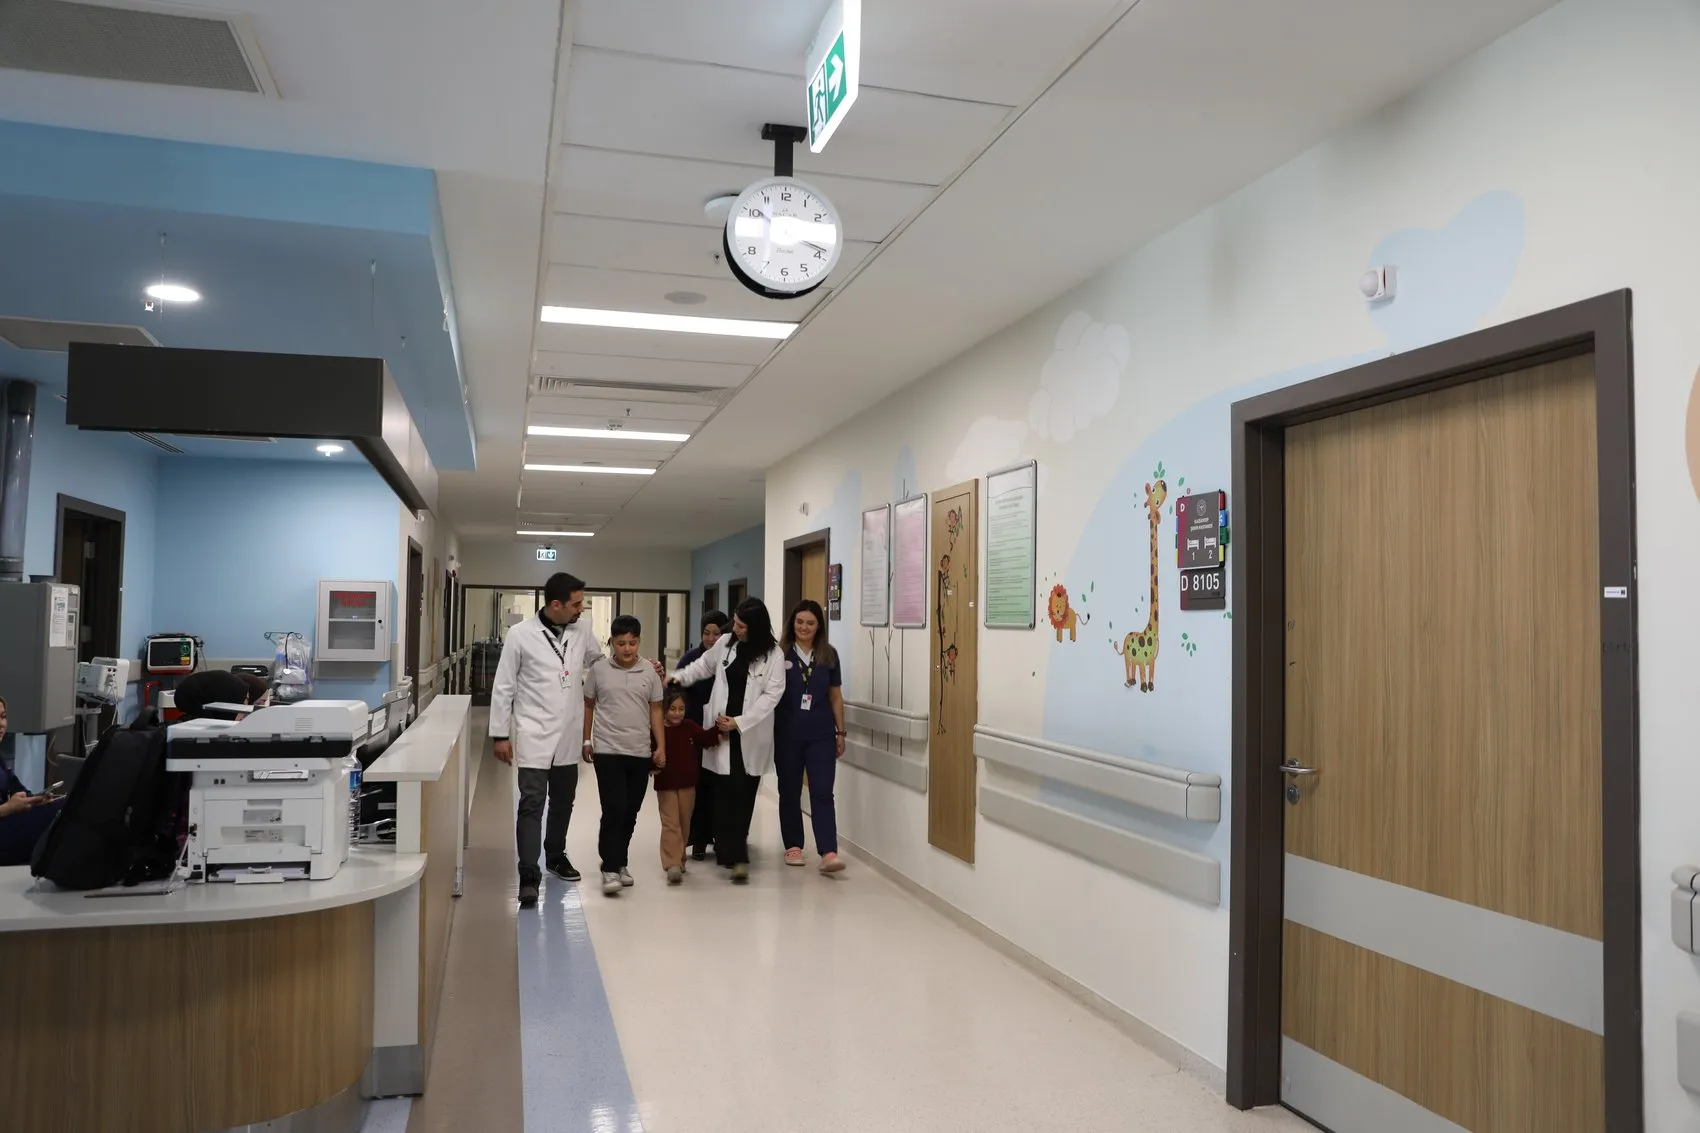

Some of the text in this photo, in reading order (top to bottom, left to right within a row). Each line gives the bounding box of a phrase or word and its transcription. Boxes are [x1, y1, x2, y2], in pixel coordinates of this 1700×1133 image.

[781, 192, 792, 202] 12
[749, 209, 760, 217] 10
[814, 214, 822, 222] 2
[748, 246, 756, 255] 8
[814, 251, 822, 260] 4
[781, 268, 788, 276] 6
[800, 264, 808, 272] 5
[1180, 503, 1185, 512] D
[1192, 550, 1212, 560] 1 2
[1181, 573, 1220, 591] D 8105
